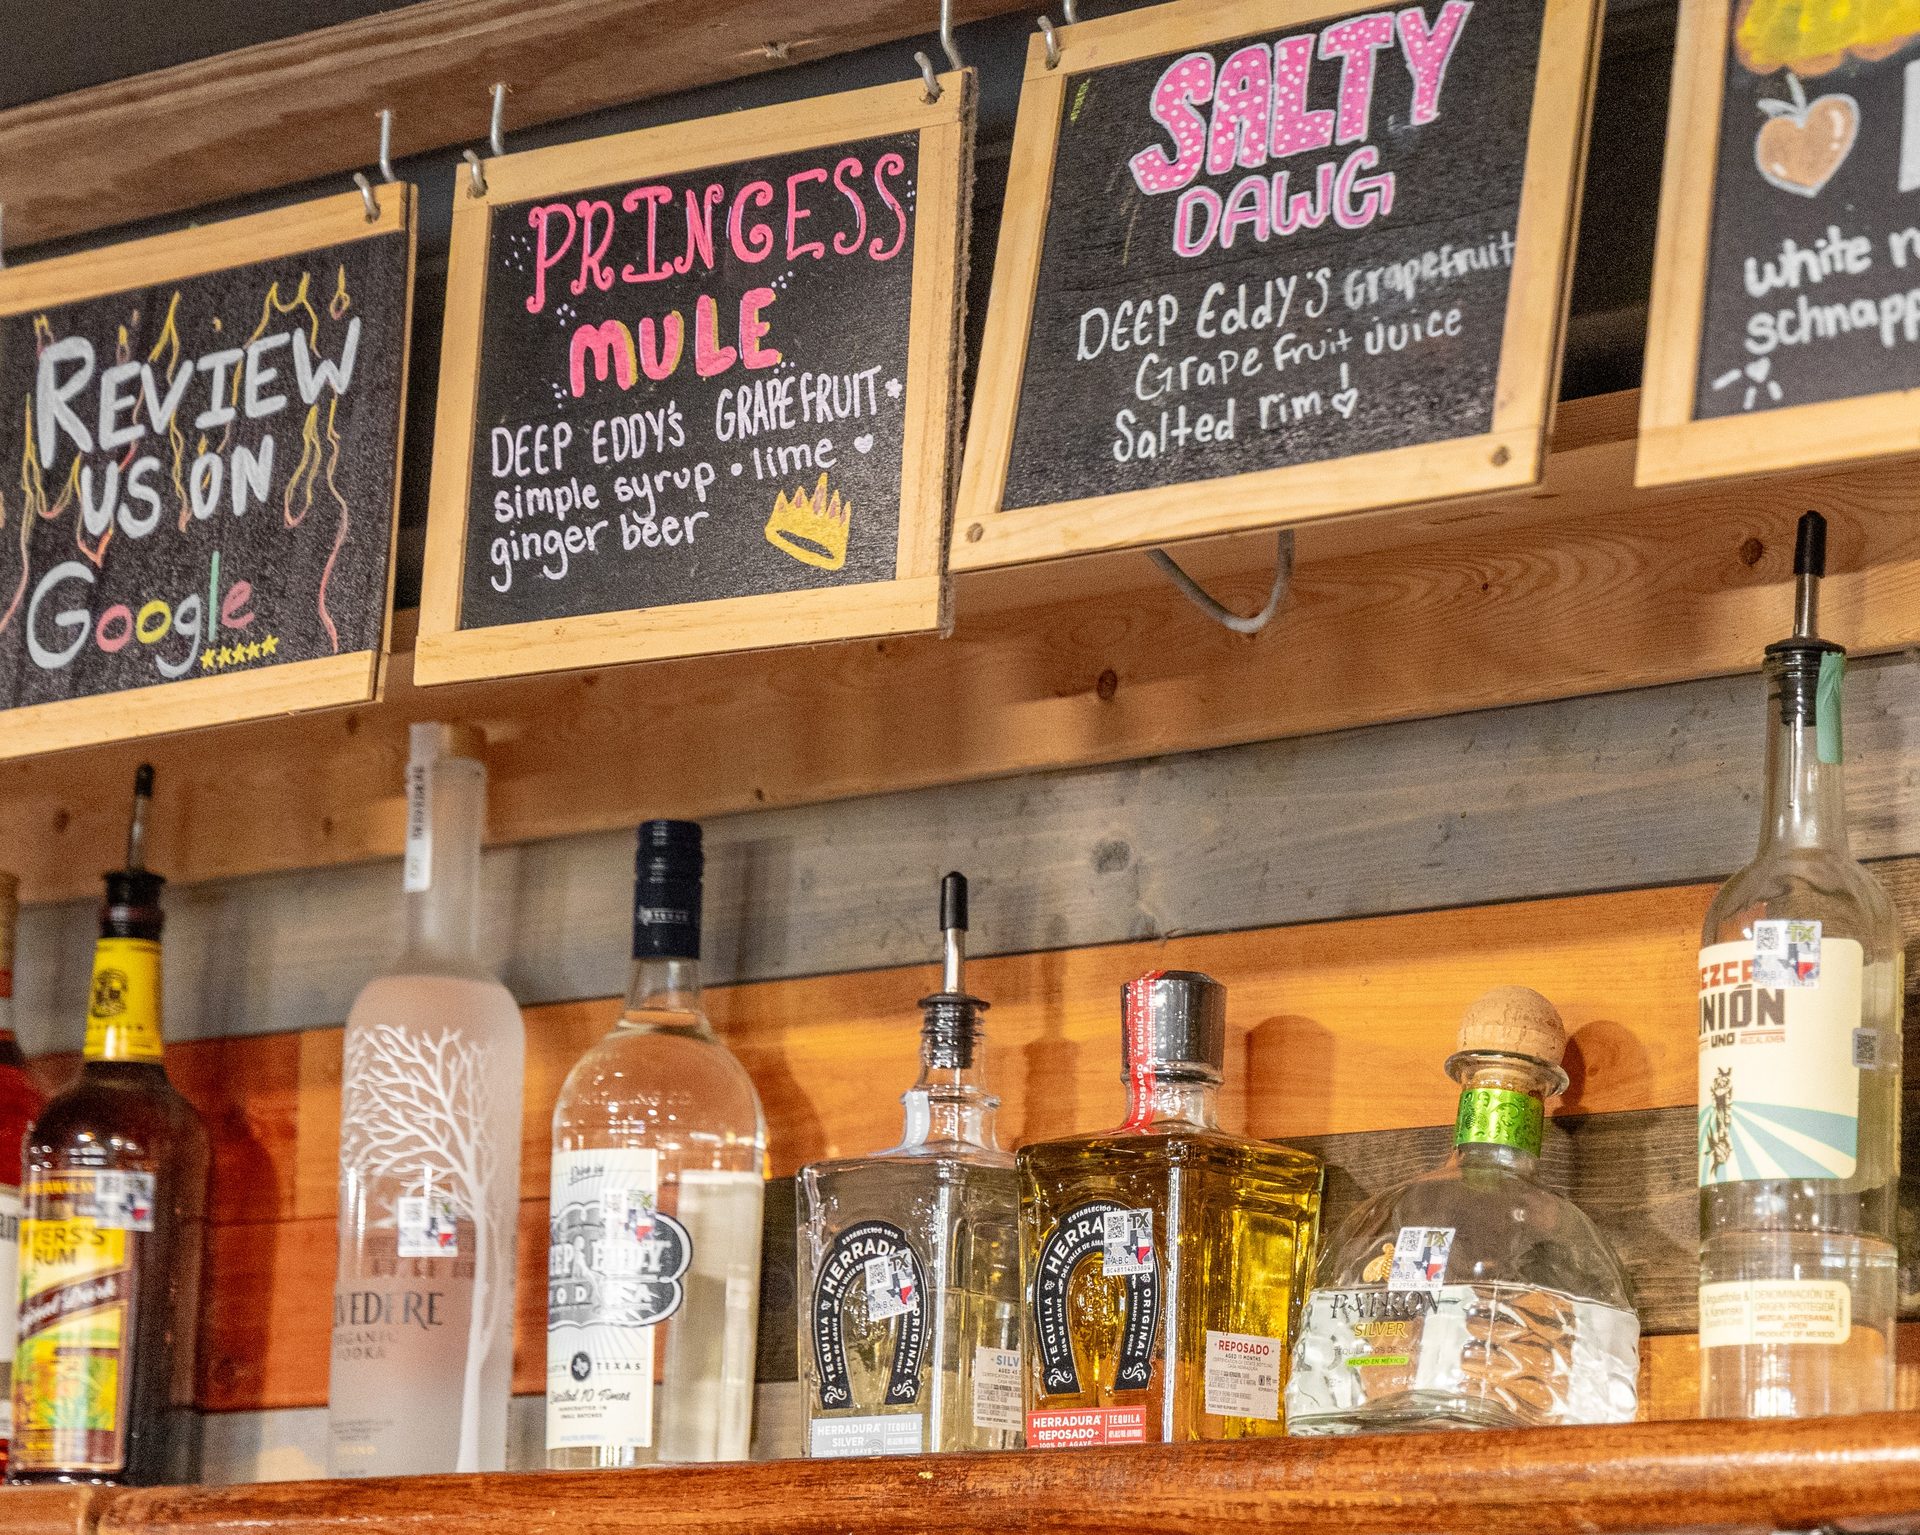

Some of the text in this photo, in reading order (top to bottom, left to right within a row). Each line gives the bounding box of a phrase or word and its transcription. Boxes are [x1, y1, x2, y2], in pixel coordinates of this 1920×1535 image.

[1129, 0, 1474, 196] SALTY
[525, 152, 907, 315] PRINCESS
[1172, 145, 1396, 258] DAWG
[1744, 224, 1872, 298] white
[569, 287, 784, 399] MULE
[1135, 347, 1263, 401] Grape
[36, 317, 361, 469] REVIEW
[491, 422, 574, 478] DEEP
[715, 364, 882, 443] GRAPEFRUIT
[1113, 399, 1236, 463] Salted
[81, 435, 274, 539] US ON
[493, 437, 838, 524] simple syrup lime
[490, 511, 709, 594] ginger beer
[27, 550, 254, 678] Google
[1787, 924, 1816, 943] TX
[1699, 984, 1784, 1036] NIÓN
[1711, 1032, 1735, 1048] UNO
[1137, 1063, 1146, 1120] REPOSADO
[1129, 1212, 1149, 1229] TX
[890, 1253, 909, 1271] TX
[821, 1317, 836, 1382] TEQUILA
[904, 1309, 920, 1374] ORIGINAL
[1045, 1297, 1060, 1364] TEQUILA
[1134, 1288, 1151, 1357] ORIGINAL
[1218, 1340, 1270, 1356] REPOSADO
[1355, 1321, 1408, 1338] SILVER
[596, 1362, 641, 1370] TEXAS
[817, 1424, 881, 1436] HERRADURA
[832, 1437, 864, 1447] SILVER
[1033, 1414, 1140, 1428] HERRADURA TEQUILA
[1038, 1428, 1094, 1441] REPOSADO
